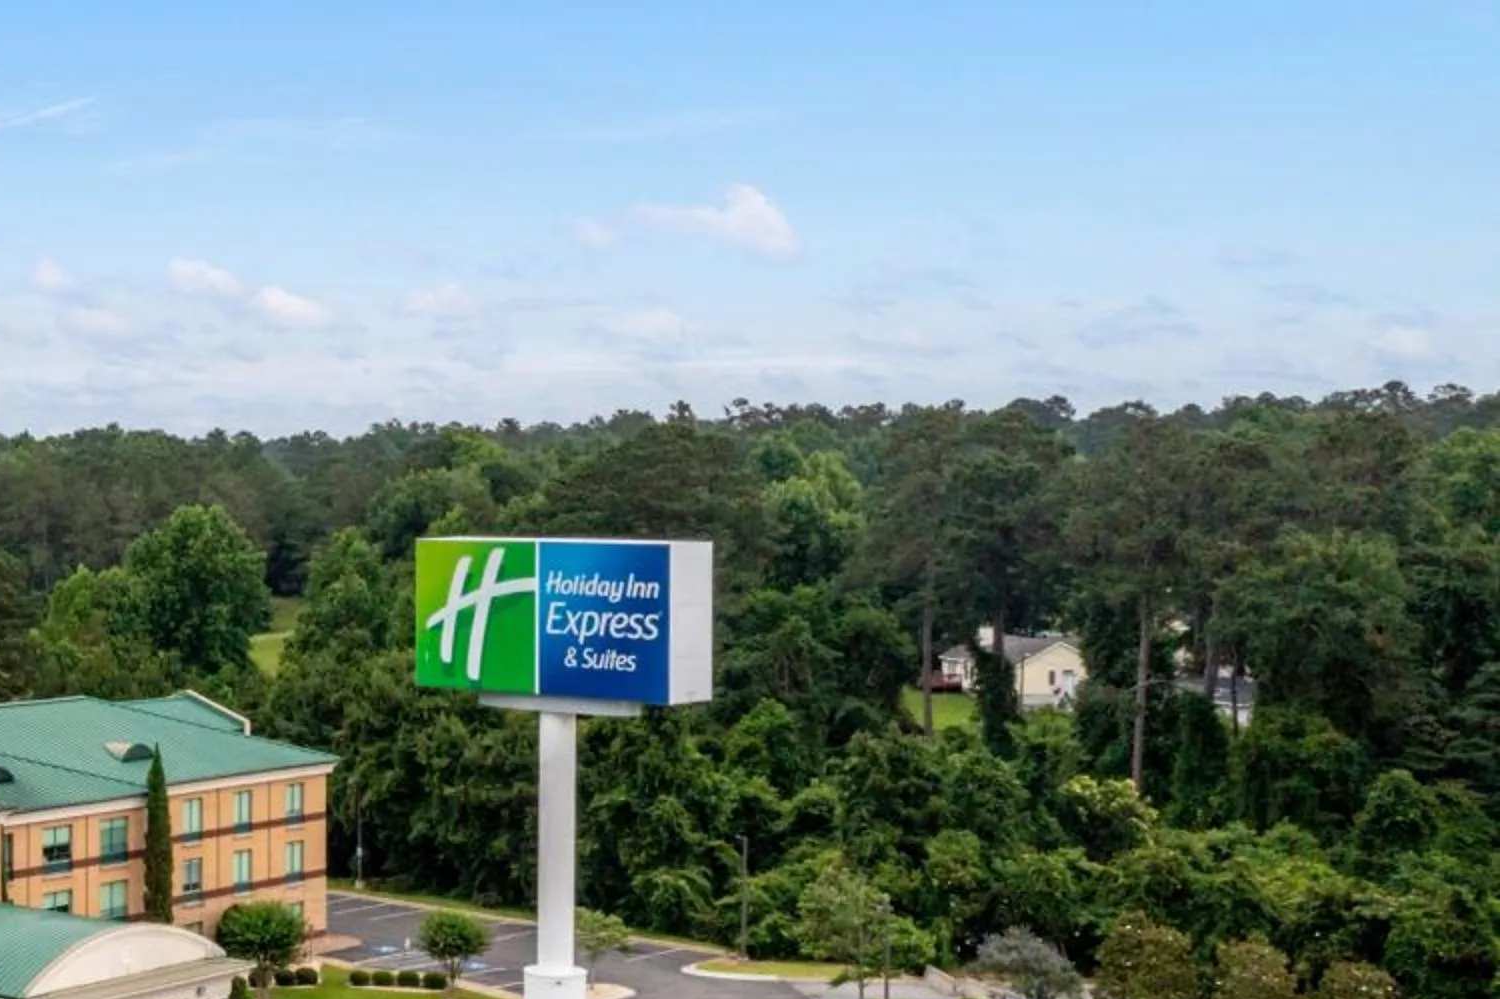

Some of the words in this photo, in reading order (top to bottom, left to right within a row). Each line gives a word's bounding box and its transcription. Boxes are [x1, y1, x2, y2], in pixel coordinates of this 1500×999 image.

[545, 570, 625, 604] Holiday
[626, 572, 660, 600] Inn
[545, 601, 660, 645] Express
[563, 645, 578, 668] &
[580, 647, 637, 672] Suites
